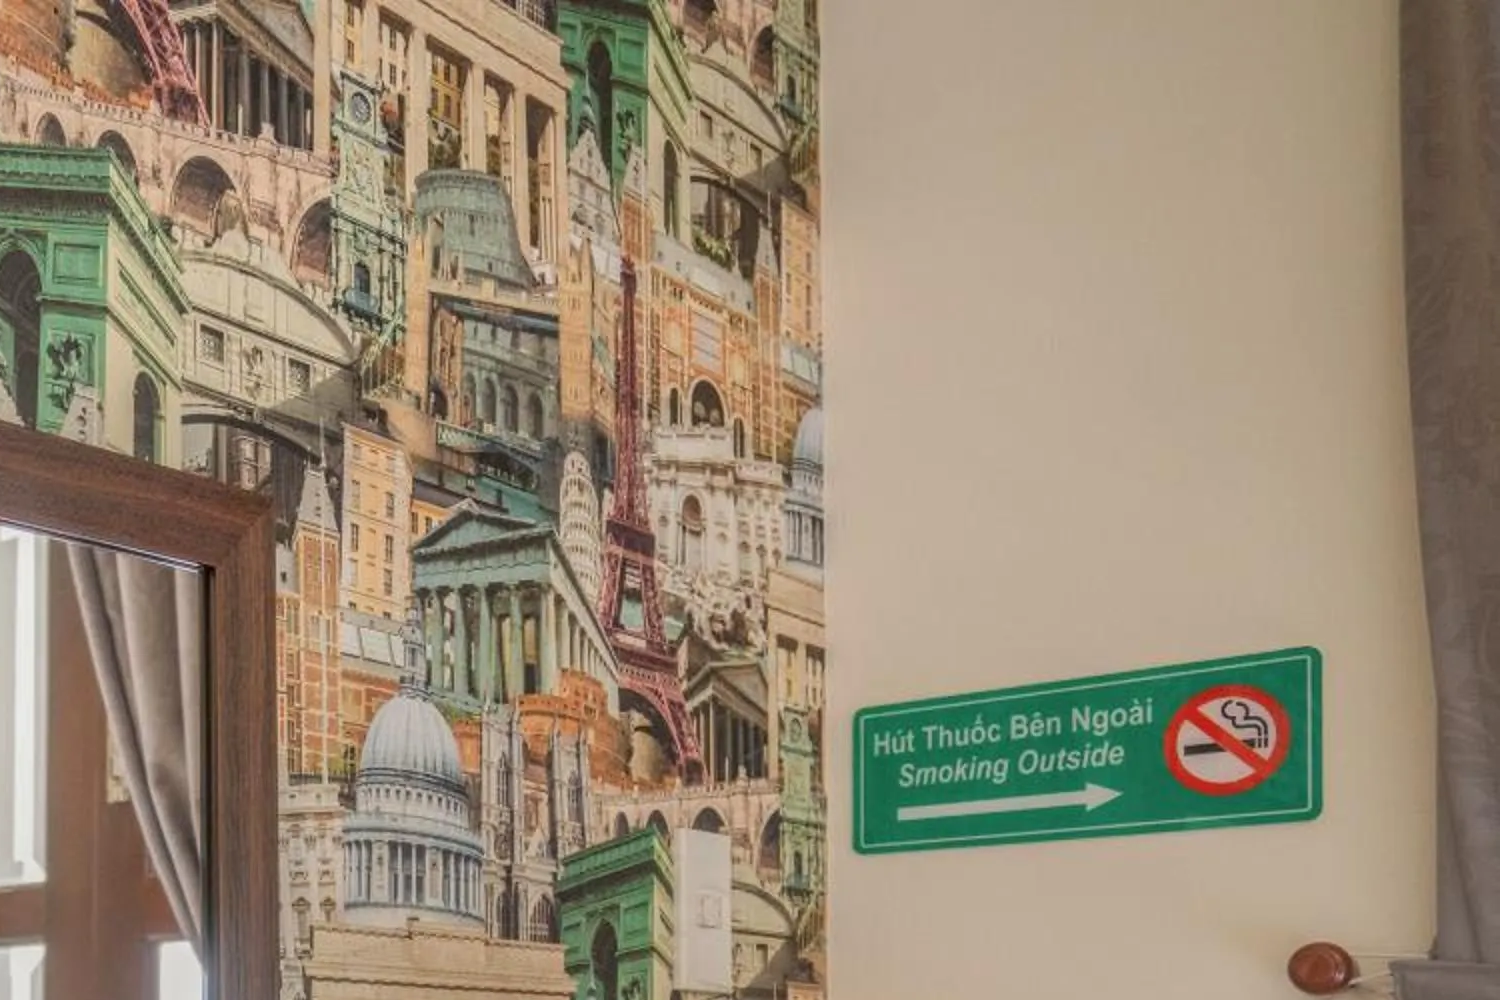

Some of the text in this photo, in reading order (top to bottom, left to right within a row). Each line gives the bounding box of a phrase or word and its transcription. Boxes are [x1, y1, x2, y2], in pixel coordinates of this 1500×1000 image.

[873, 697, 1153, 758] Hút Thuốc Bên Ngoài
[899, 741, 1125, 787] Smoking Outside
